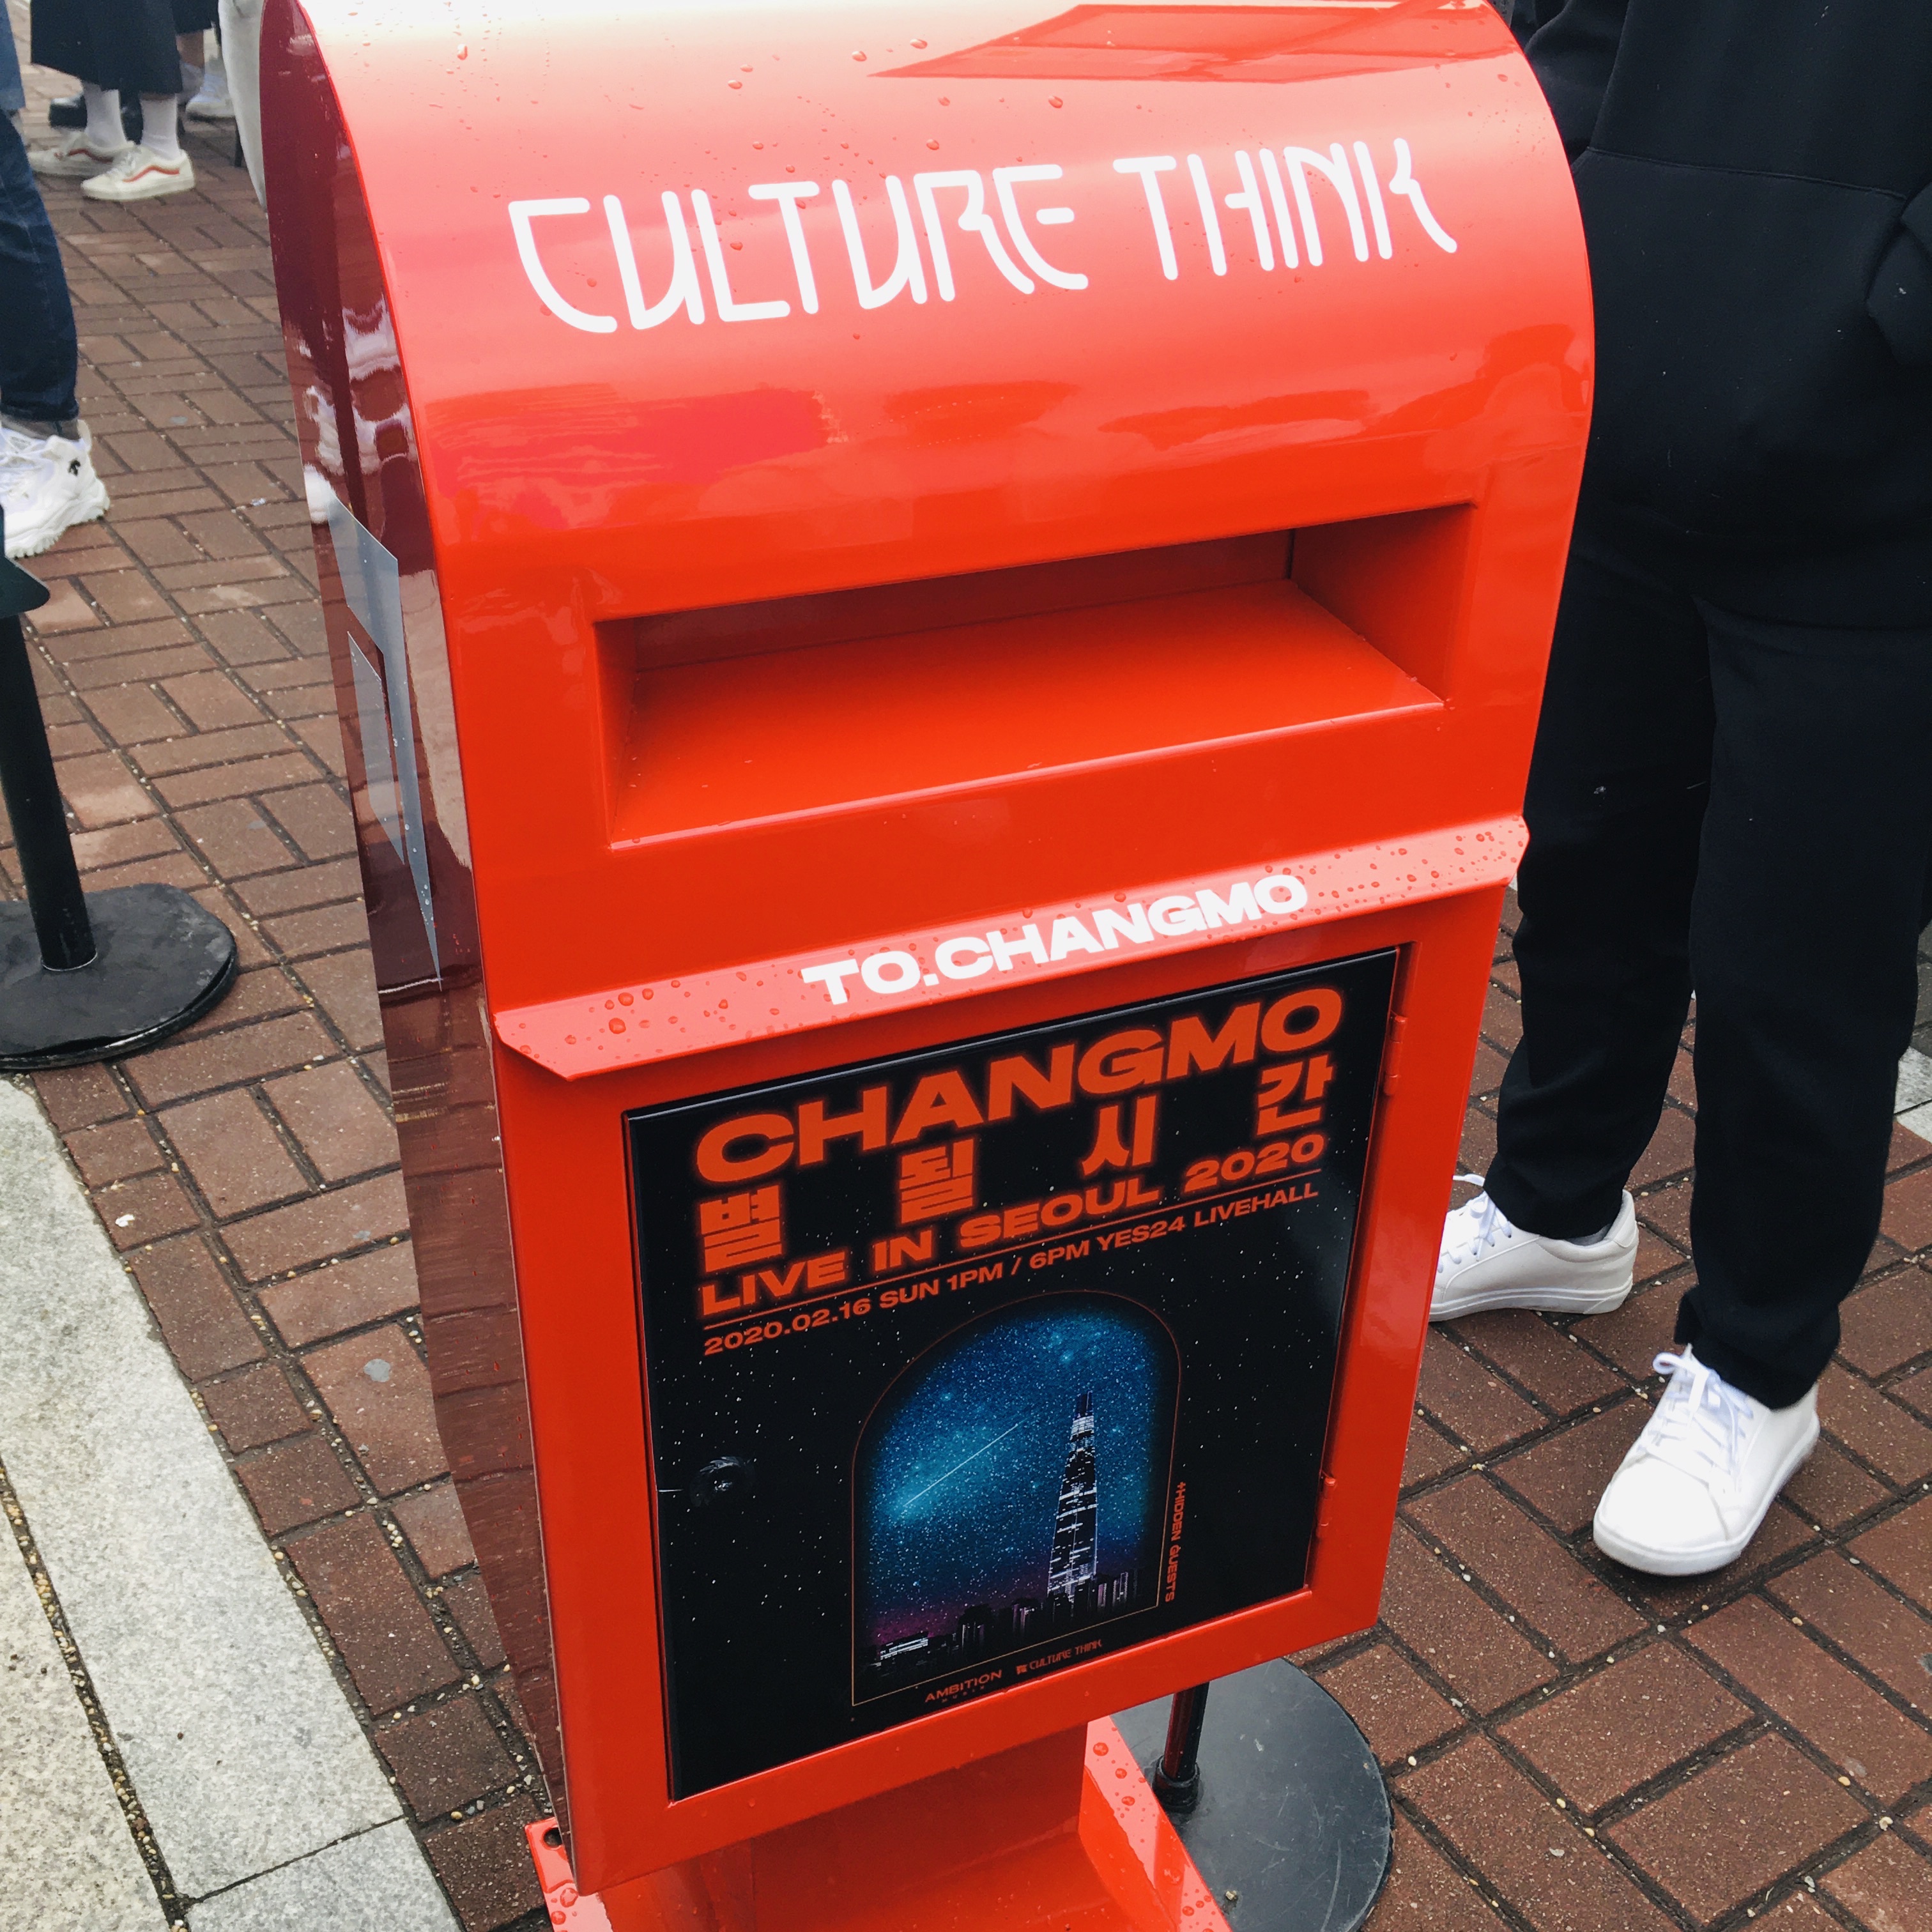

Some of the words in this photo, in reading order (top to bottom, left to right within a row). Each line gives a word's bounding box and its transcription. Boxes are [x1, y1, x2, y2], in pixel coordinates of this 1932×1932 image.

[508, 165, 1089, 334] CULTURE
[1113, 137, 1457, 281] THINK
[801, 874, 1308, 1006] TO.CHANGMO
[696, 988, 1342, 1183] CHANGMO
[700, 1185, 783, 1273] 별
[900, 1139, 974, 1224] 될
[1082, 1096, 1156, 1176] 시
[1257, 1055, 1333, 1136] 간
[703, 1252, 847, 1316] LIVE
[873, 1231, 934, 1271] IN
[960, 1179, 1162, 1248] SEOUL
[1183, 1135, 1324, 1193] 2020
[704, 1301, 871, 1355] 2020.02.16
[879, 1280, 940, 1310] SUN
[946, 1264, 1003, 1292] 1PM
[1029, 1243, 1090, 1269] 6PM
[1097, 1216, 1186, 1251] YES24
[1193, 1183, 1319, 1227] LIVEHALL
[1029, 1648, 1073, 1669] CULTURE
[1074, 1639, 1102, 1655] THINK
[1165, 1544, 1181, 1602] GUESTS
[924, 1669, 1002, 1703] AMBITION
